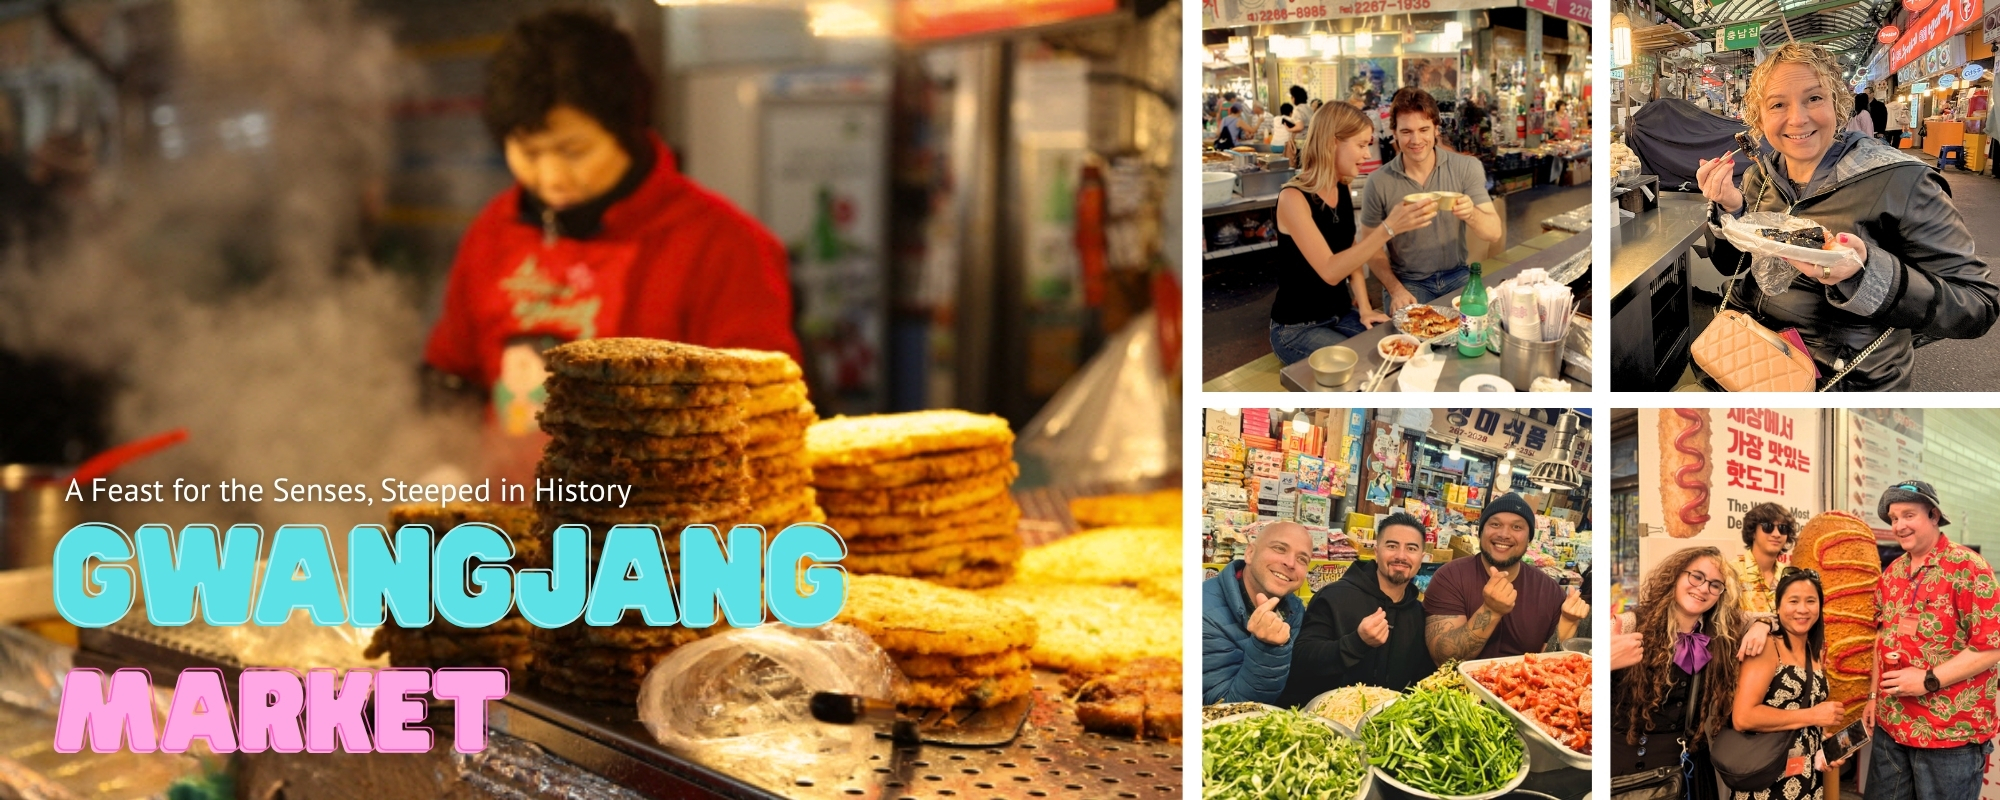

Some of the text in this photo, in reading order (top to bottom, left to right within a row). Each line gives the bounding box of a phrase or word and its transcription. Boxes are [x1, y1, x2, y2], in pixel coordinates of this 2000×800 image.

[1727, 27, 1758, 41] 충남집
[1448, 408, 1548, 451] 미식품
[1449, 426, 1488, 443] 267-2028
[1727, 427, 1810, 473] 가장 맛있는
[1726, 459, 1785, 496] 핫도그!
[1727, 498, 1748, 513] The
[1790, 507, 1810, 520] Most
